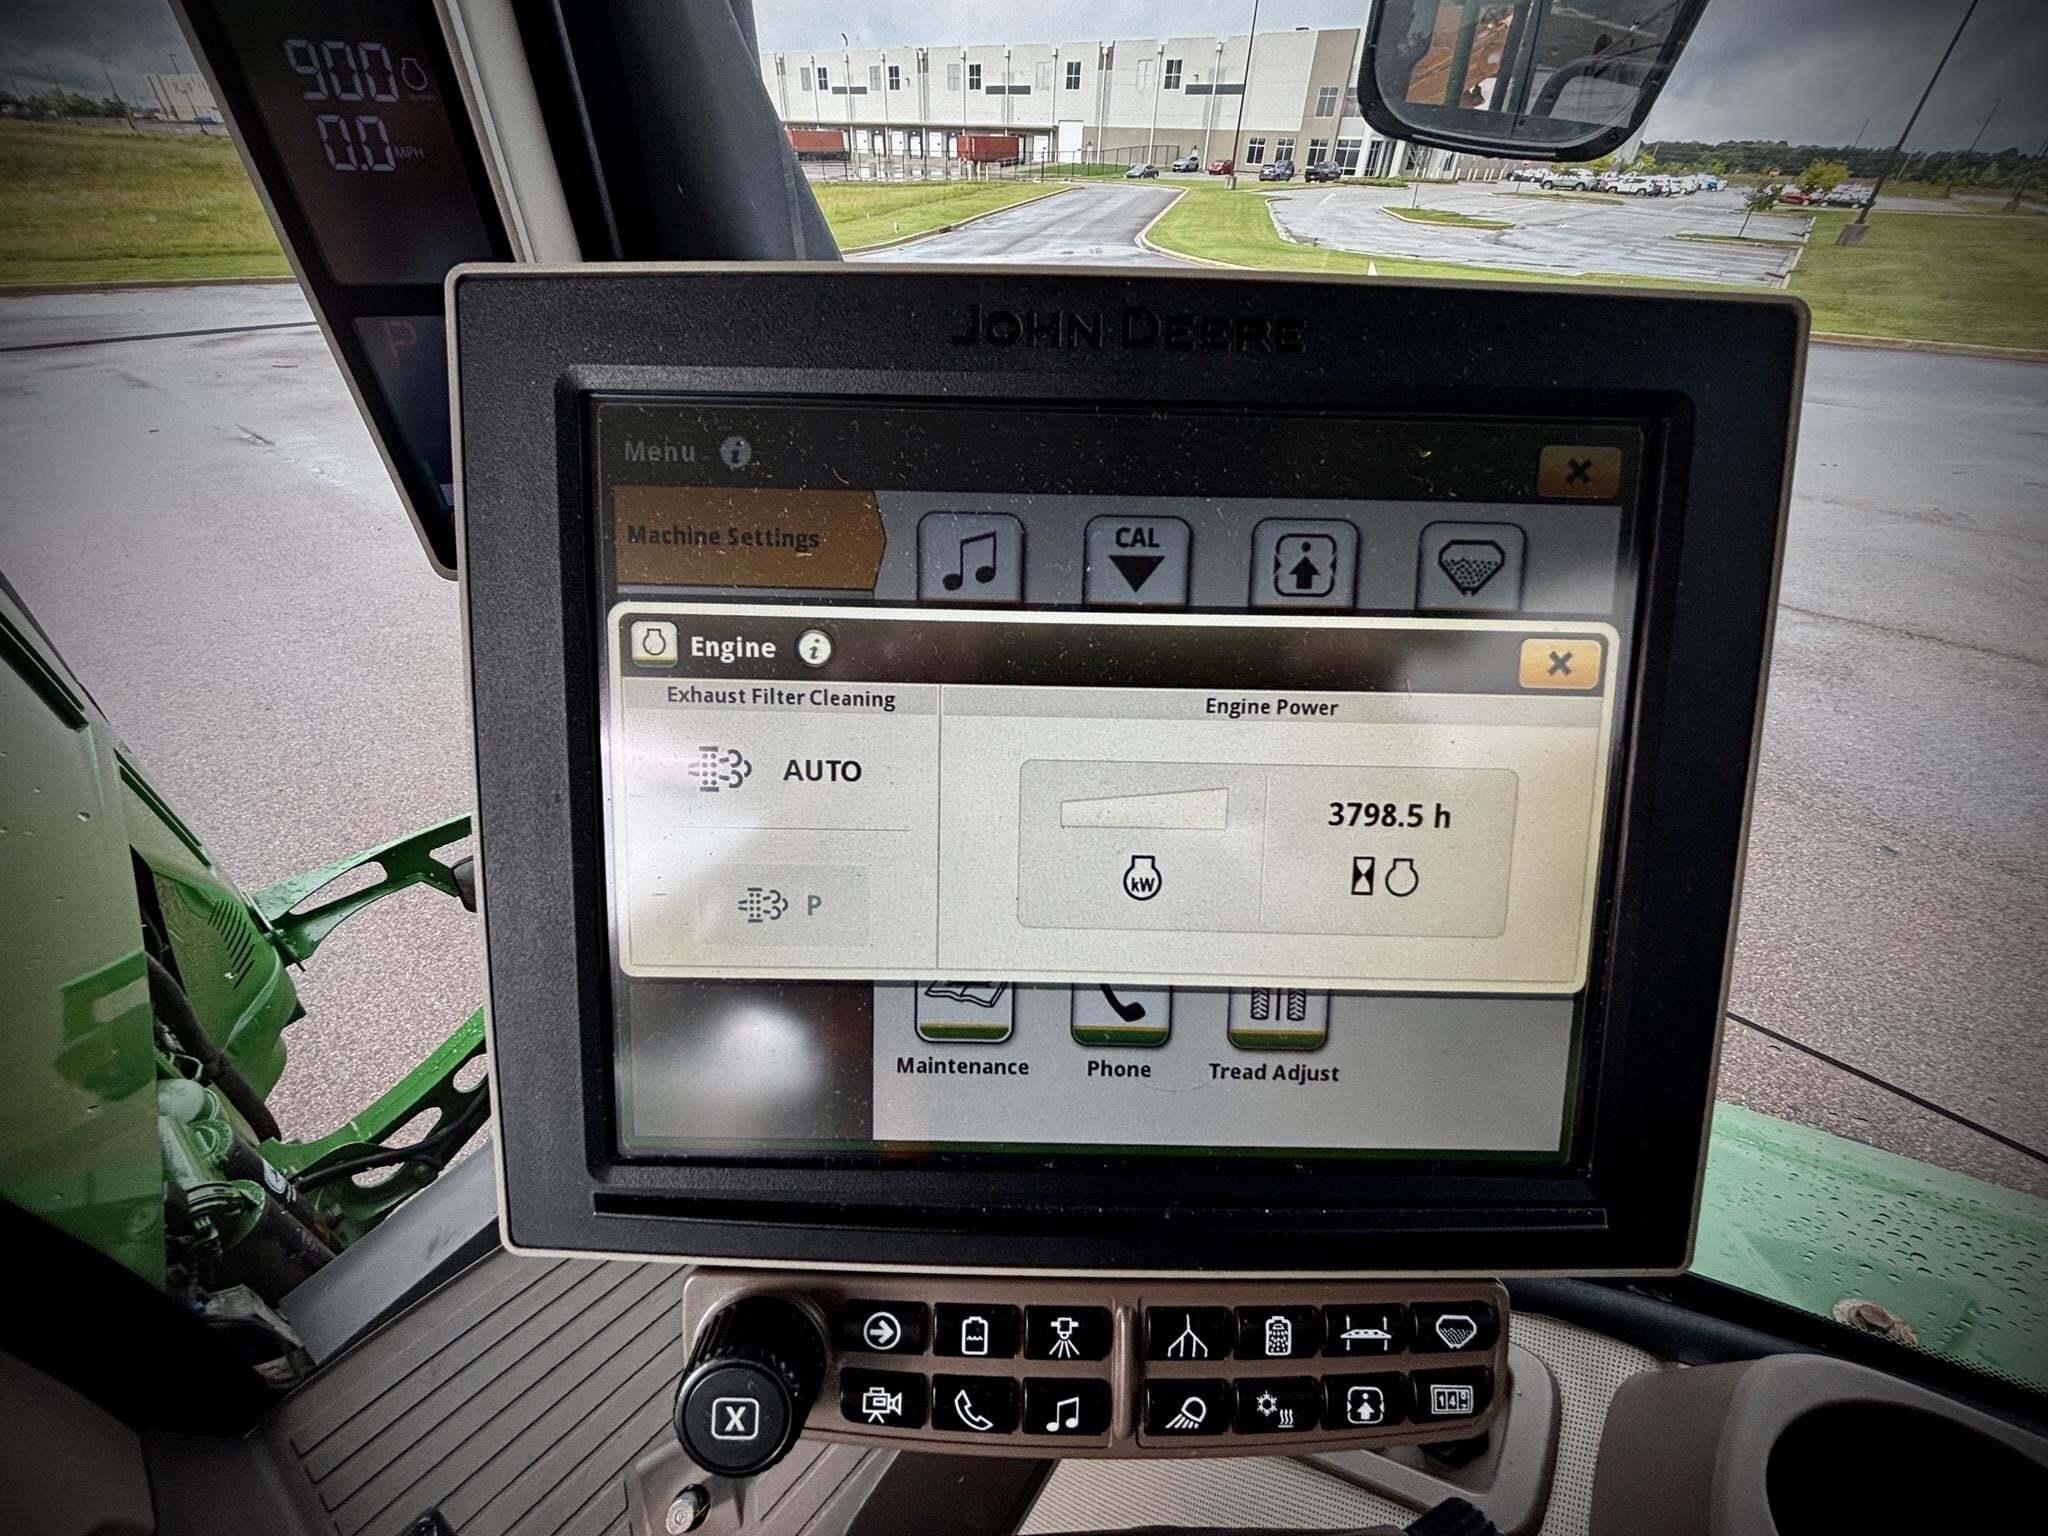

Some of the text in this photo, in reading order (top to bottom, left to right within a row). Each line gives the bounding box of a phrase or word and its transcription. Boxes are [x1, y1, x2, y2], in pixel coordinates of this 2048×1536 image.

[284, 39, 399, 102] 900
[953, 304, 1307, 352] JOHN DEERE
[624, 440, 696, 463] Menu
[627, 525, 820, 552] Machine Settings
[1116, 527, 1160, 549] CAL
[690, 636, 777, 663] Engine
[667, 686, 896, 712] Exhaust Filter Cleaning
[1206, 698, 1339, 718] Engine Power
[783, 759, 863, 783] AUTO
[1327, 803, 1452, 829] 3798.5 h
[1131, 876, 1155, 894] kW
[807, 894, 823, 915] P
[896, 1057, 1030, 1076] Maintenance
[1087, 1060, 1152, 1079] Phone
[1209, 1062, 1340, 1085] Tread Adjust
